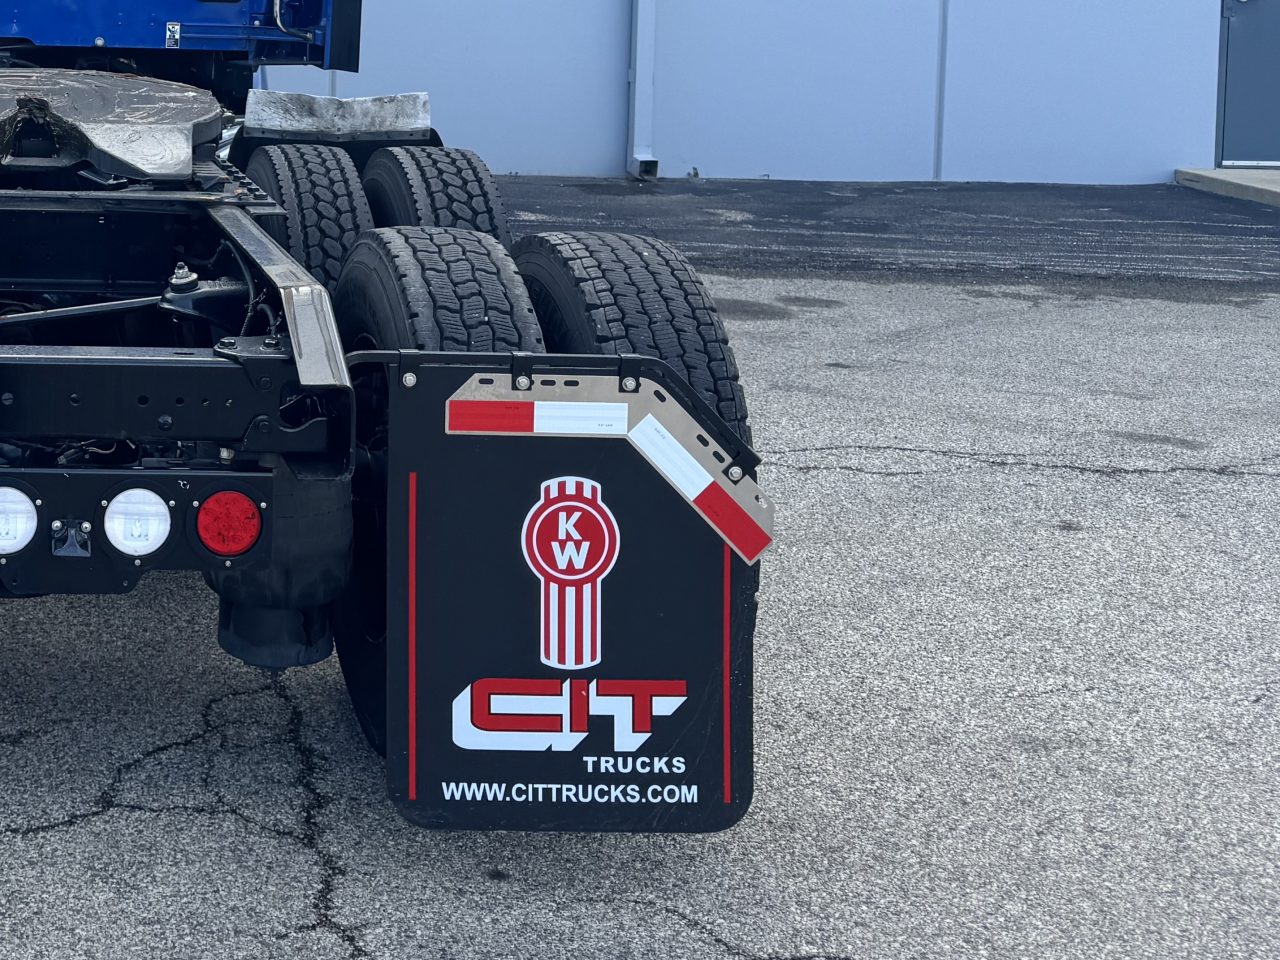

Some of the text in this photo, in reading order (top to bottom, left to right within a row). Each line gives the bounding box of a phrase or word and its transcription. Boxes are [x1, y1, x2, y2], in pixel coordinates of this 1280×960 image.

[452, 677, 688, 752] CIT
[583, 756, 686, 774] TRUCKS
[442, 782, 698, 804] WWW.CITTRUCKS.COM
